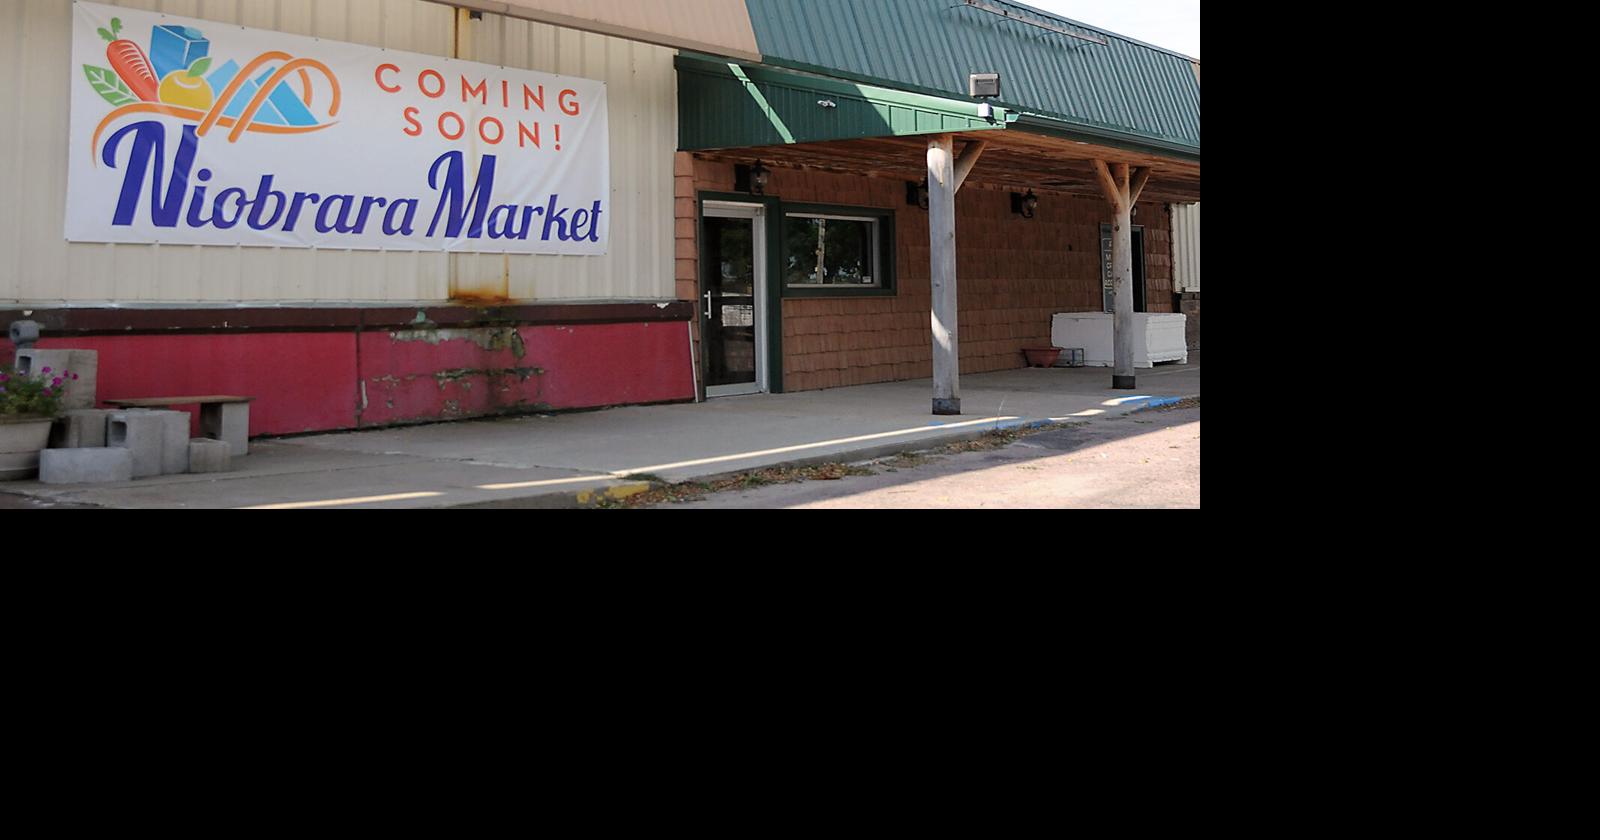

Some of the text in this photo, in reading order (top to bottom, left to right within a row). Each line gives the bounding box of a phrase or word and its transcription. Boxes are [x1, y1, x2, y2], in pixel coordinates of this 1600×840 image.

[374, 63, 581, 116] COMING
[402, 106, 563, 151] SOON!
[102, 120, 603, 243] Niobrara Market
